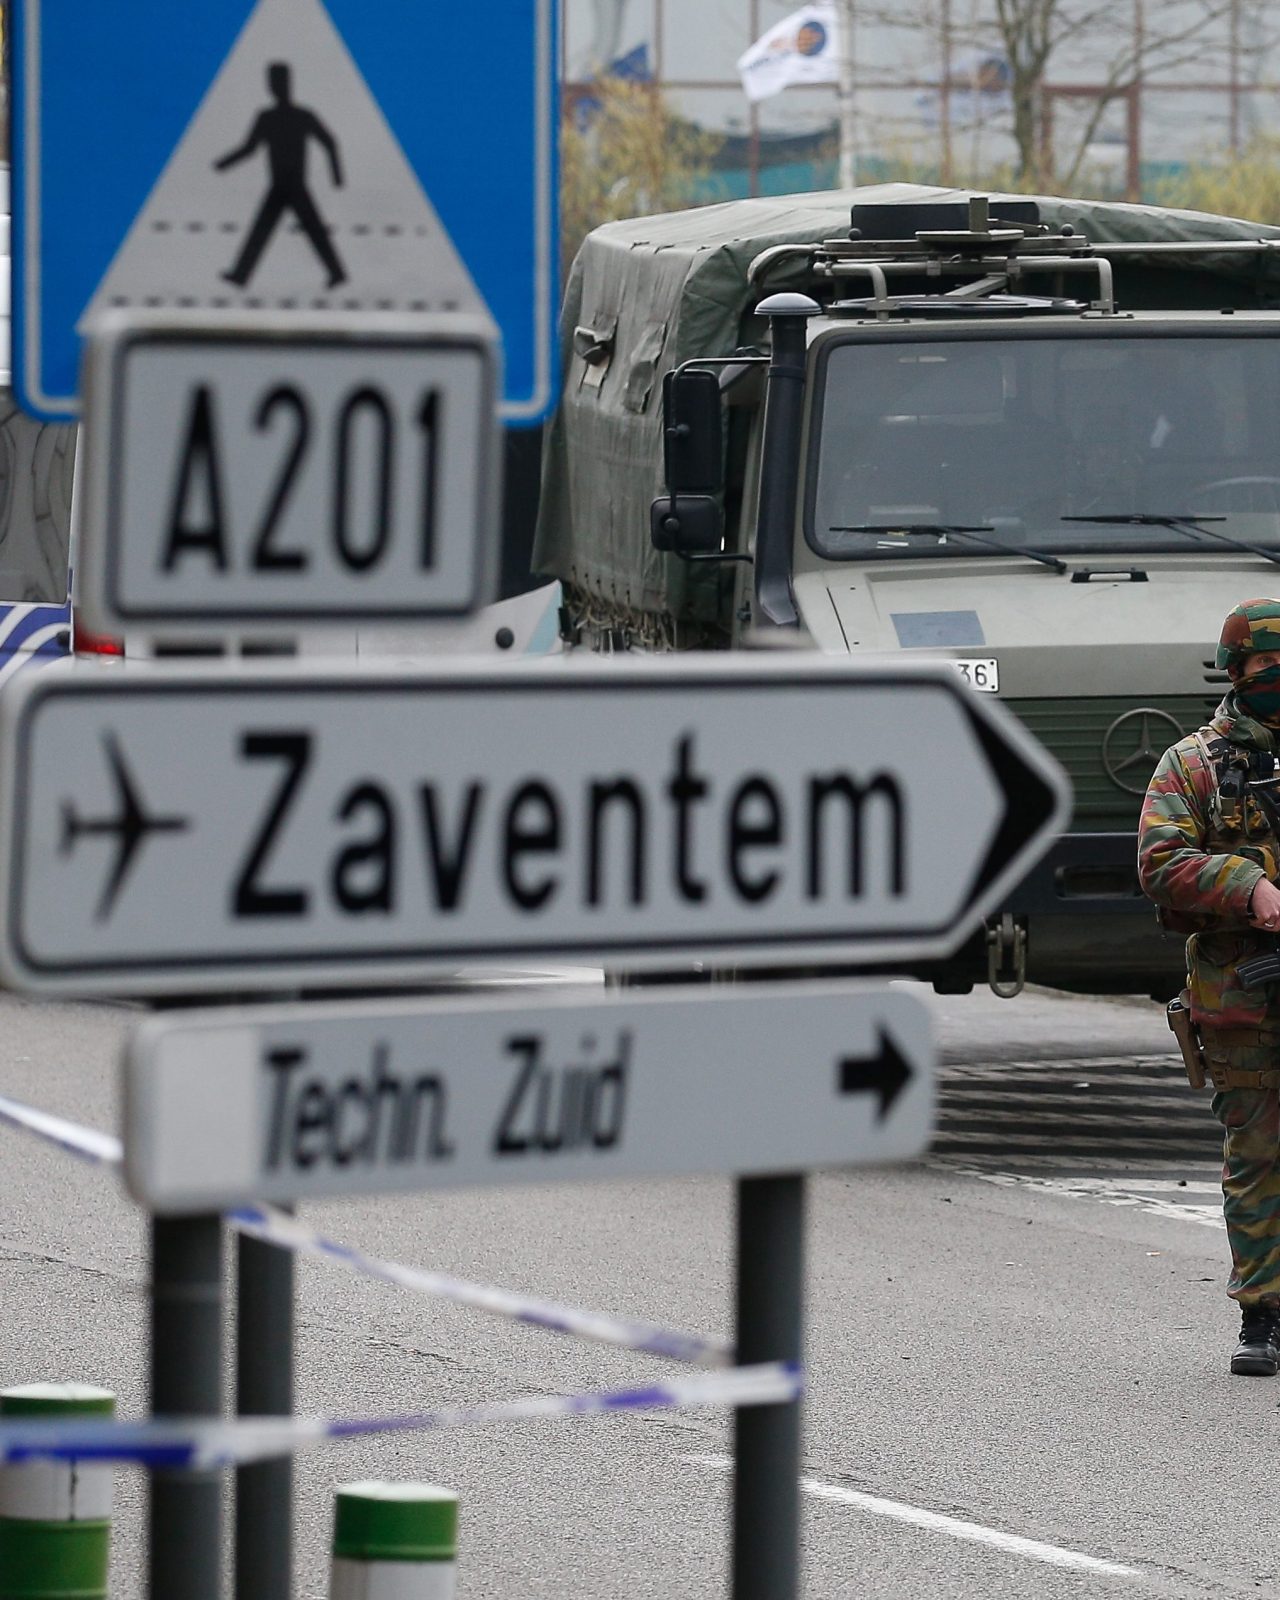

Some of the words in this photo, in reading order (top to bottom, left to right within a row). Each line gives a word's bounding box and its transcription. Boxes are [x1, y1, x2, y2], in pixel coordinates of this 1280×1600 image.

[160, 380, 442, 574] A201
[229, 727, 907, 919] Zaventem
[262, 1036, 453, 1175] Techn.
[493, 1024, 633, 1160] Zuid
